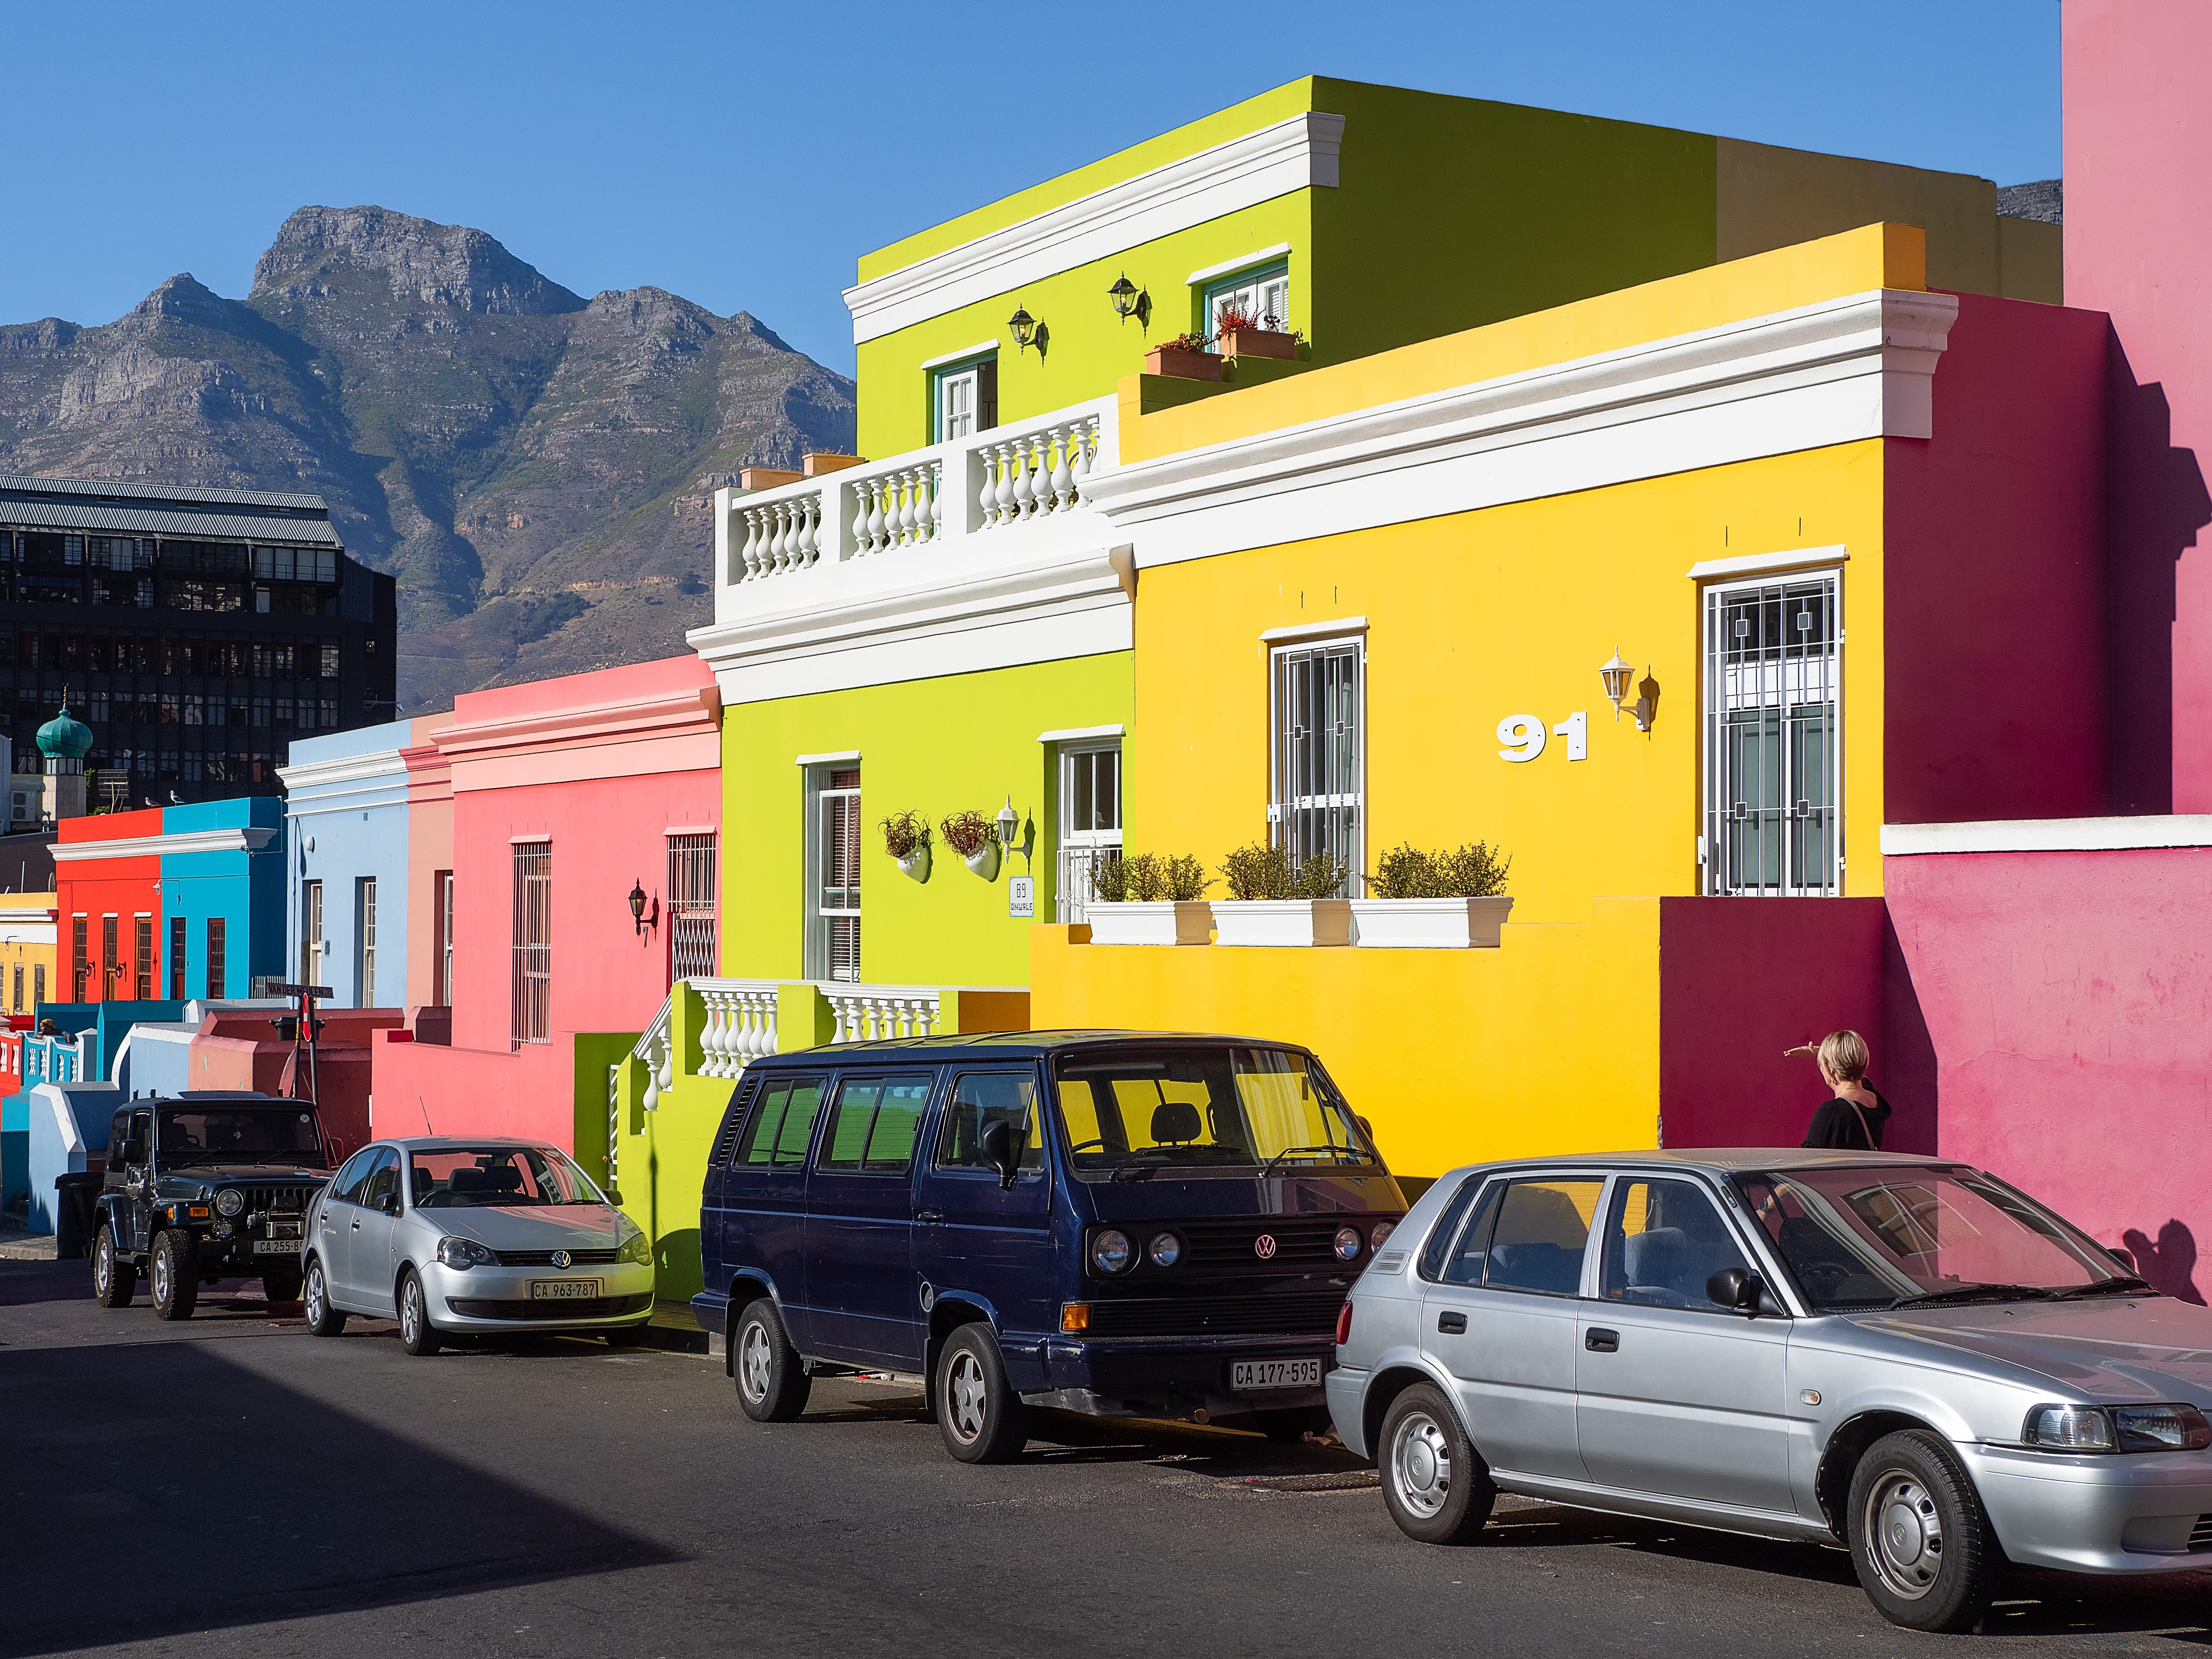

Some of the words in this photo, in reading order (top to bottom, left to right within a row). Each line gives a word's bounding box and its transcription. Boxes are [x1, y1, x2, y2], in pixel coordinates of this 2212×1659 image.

[1496, 711, 1587, 763] 91
[1017, 883, 1026, 898] 89
[643, 926, 648, 948] 7
[269, 984, 281, 994] VAN
[283, 985, 295, 995] DER
[297, 986, 323, 997] MEULEN
[260, 1241, 271, 1252] CA
[1255, 1234, 1276, 1259] VW
[552, 1250, 571, 1267] VW
[535, 1284, 548, 1297] CA
[553, 1283, 595, 1297] 963-787
[1236, 1365, 1253, 1384] CA
[1259, 1361, 1318, 1384] 177-595
